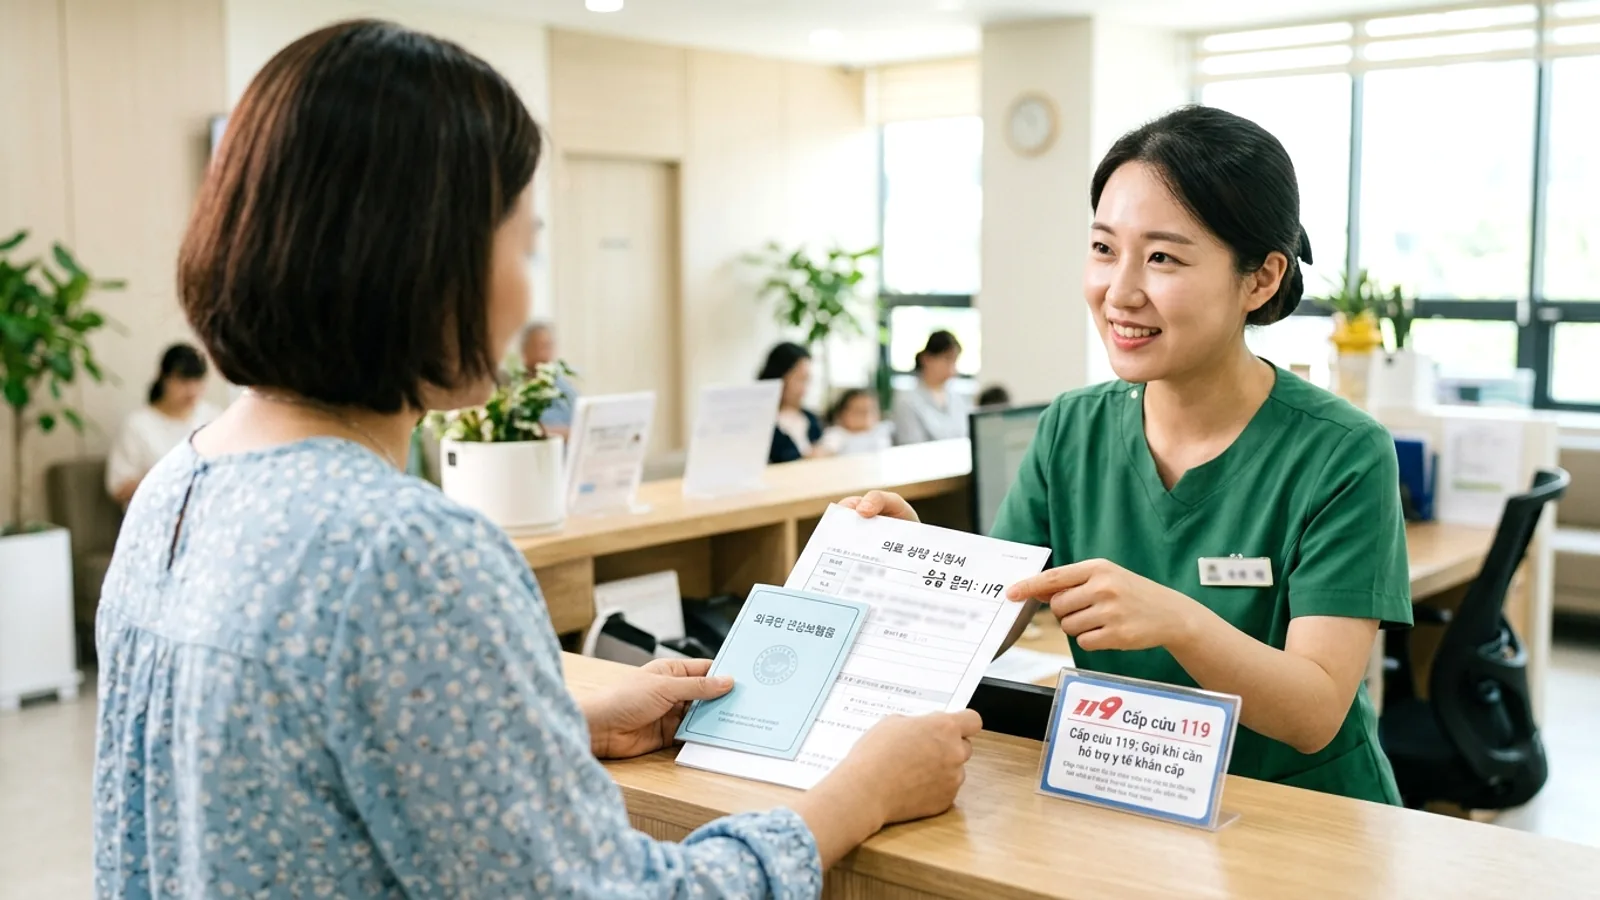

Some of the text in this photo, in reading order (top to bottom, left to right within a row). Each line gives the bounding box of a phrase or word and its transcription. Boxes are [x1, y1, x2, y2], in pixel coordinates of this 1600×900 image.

[980, 583, 1004, 599] 119
[1072, 696, 1123, 720] 119
[1122, 709, 1148, 729] Cấp
[1181, 719, 1211, 738] 119
[1141, 741, 1160, 756] Gọi
[1162, 744, 1180, 759] khi
[1112, 754, 1120, 766] y
